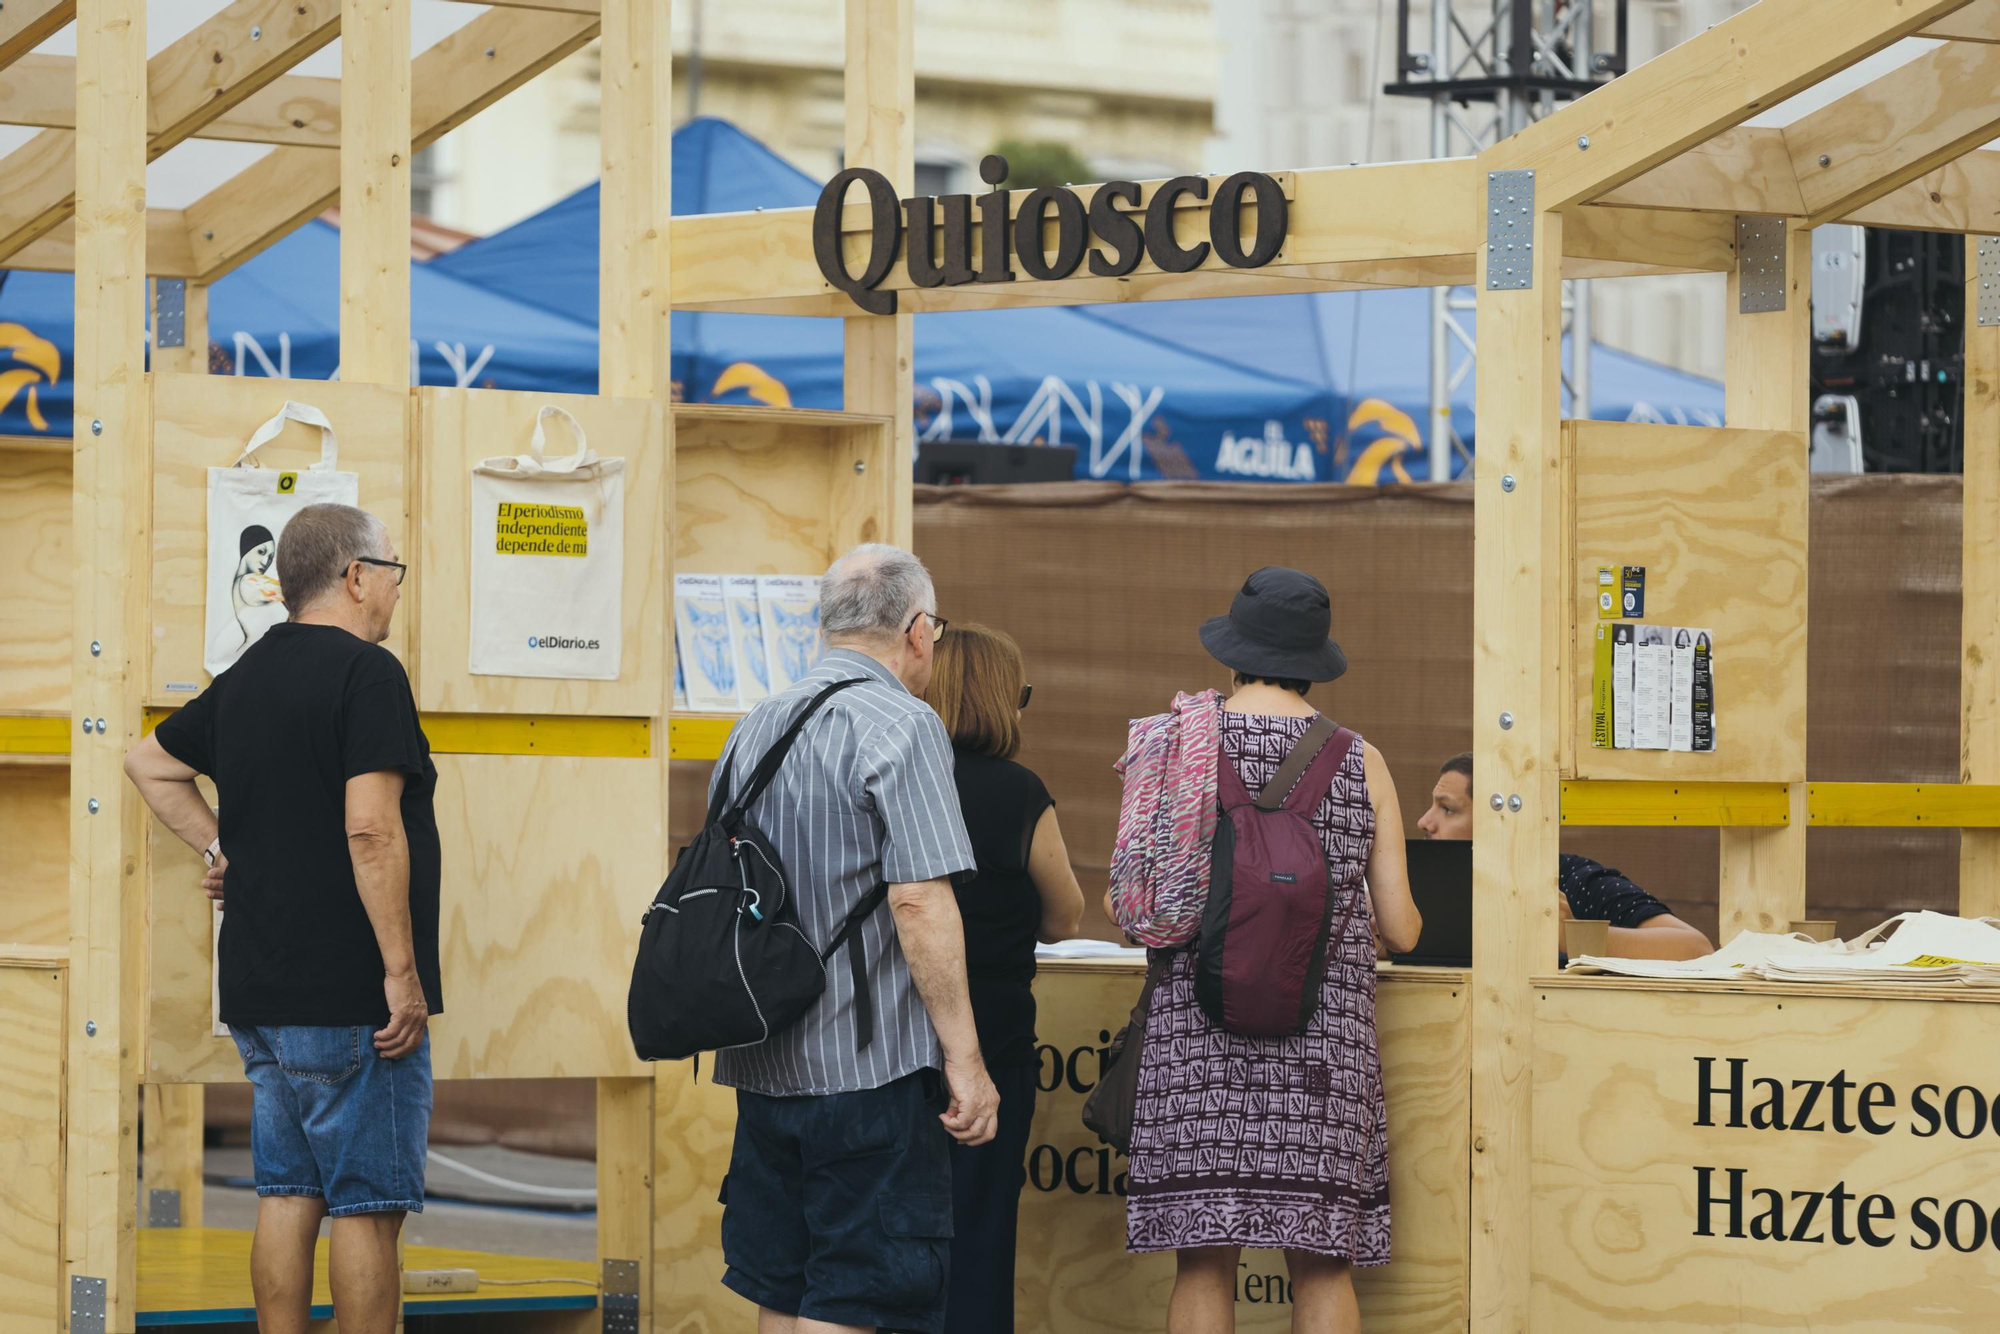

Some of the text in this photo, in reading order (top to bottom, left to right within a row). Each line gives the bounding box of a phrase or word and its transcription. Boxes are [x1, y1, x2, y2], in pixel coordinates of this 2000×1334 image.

[812, 154, 1289, 316] Quiosco
[496, 520, 588, 538] independiente
[498, 503, 584, 520] El periodismo
[496, 538, 555, 554] depende
[556, 540, 571, 553] de
[538, 635, 600, 650] elDiario.es
[1034, 1029, 1113, 1094] oci
[1693, 1056, 1896, 1135] Hazte
[1692, 1166, 1896, 1248] Hazte
